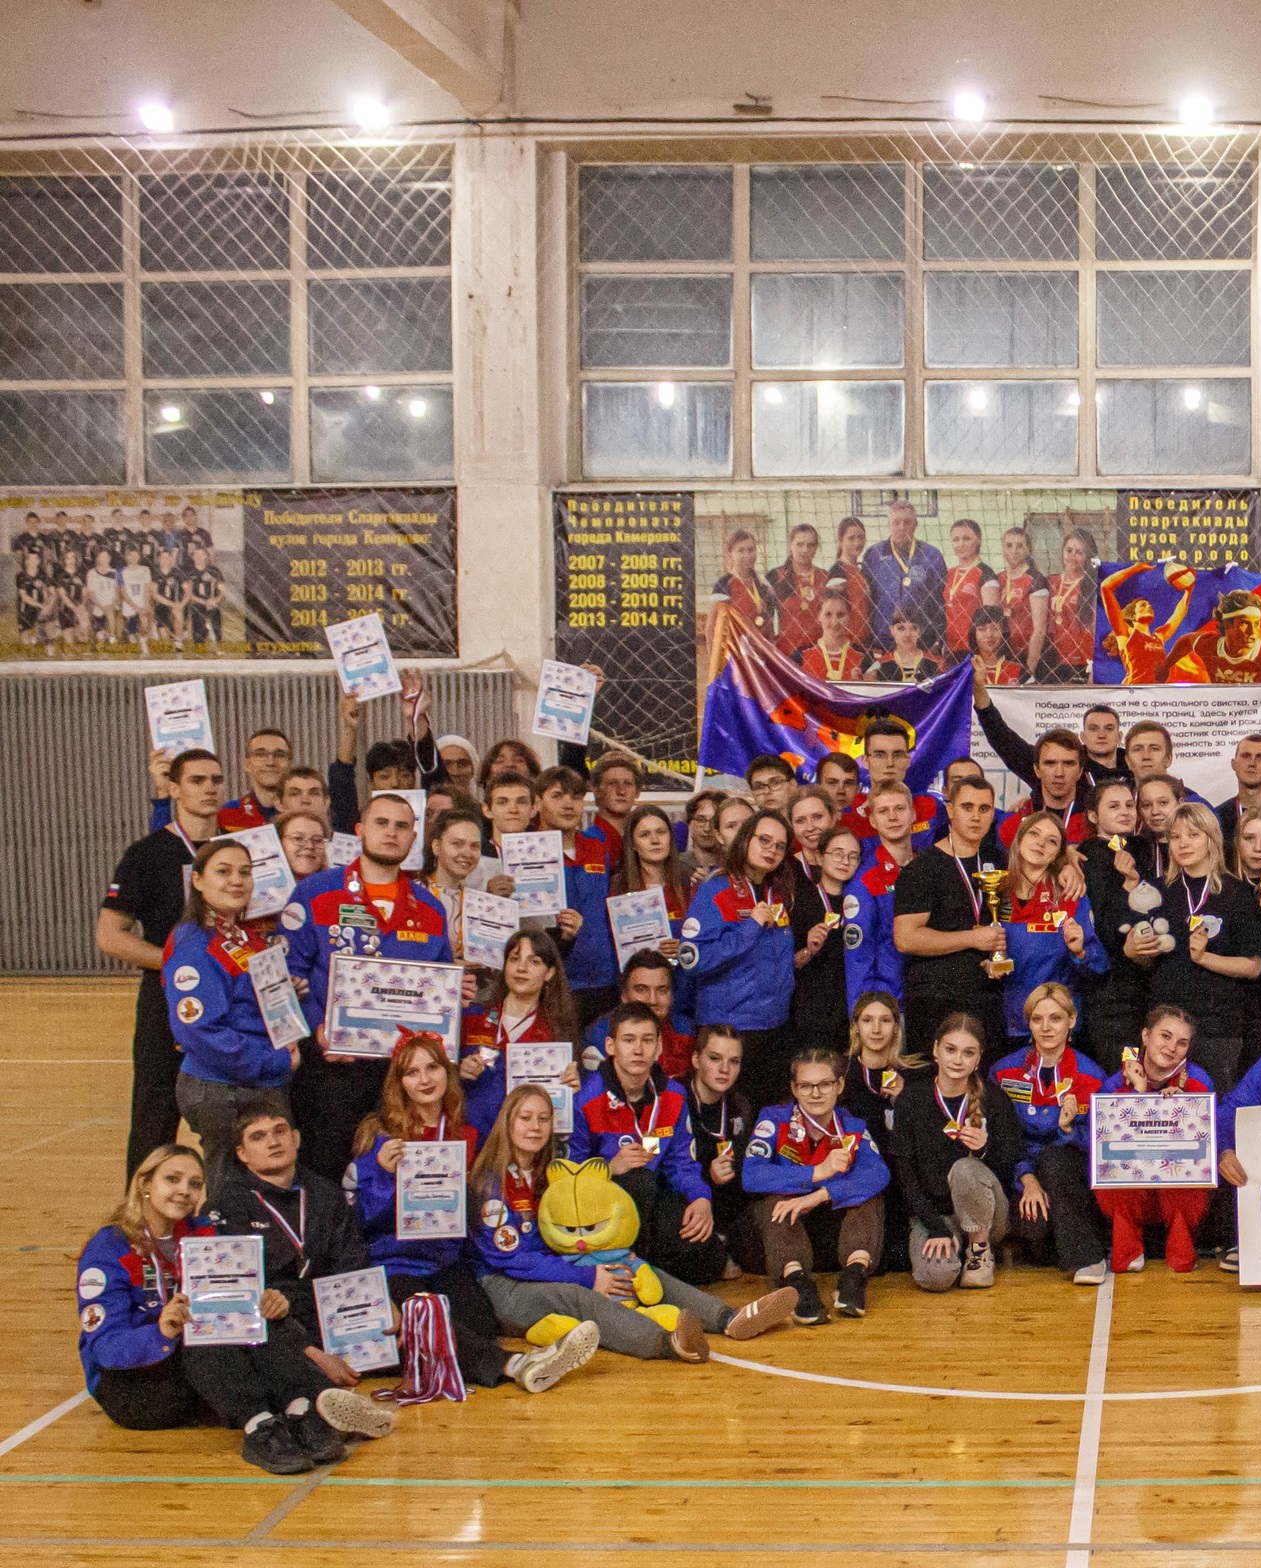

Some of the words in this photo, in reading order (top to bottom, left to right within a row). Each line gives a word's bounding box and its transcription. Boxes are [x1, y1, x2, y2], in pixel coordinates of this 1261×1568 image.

[567, 499, 681, 513] Победители
[1129, 496, 1248, 512] Победитель
[1129, 515, 1248, 529] спартакиады
[567, 533, 612, 546] города
[1129, 533, 1177, 546] вузов
[1190, 533, 1248, 546] города
[568, 555, 605, 570] 2007
[621, 554, 658, 570] 2008
[1130, 547, 1248, 563] Кемерово
[290, 559, 327, 577] 2012
[347, 558, 385, 577] 2013
[568, 573, 606, 589] 2008
[621, 573, 658, 589] 2009
[290, 584, 327, 602] 2013
[347, 583, 385, 601] 2014
[568, 592, 606, 608] 2009
[621, 592, 658, 608] 2010
[290, 609, 328, 627] 2014
[568, 611, 606, 627] 2013
[621, 611, 658, 627] 2014
[1035, 701, 1070, 710] победа
[1151, 699, 1209, 710] финального
[1211, 699, 1250, 707] свистка,
[1229, 709, 1258, 719] куется
[1190, 720, 1229, 728] команде
[1129, 1120, 1179, 1128] ДИПЛОМ
